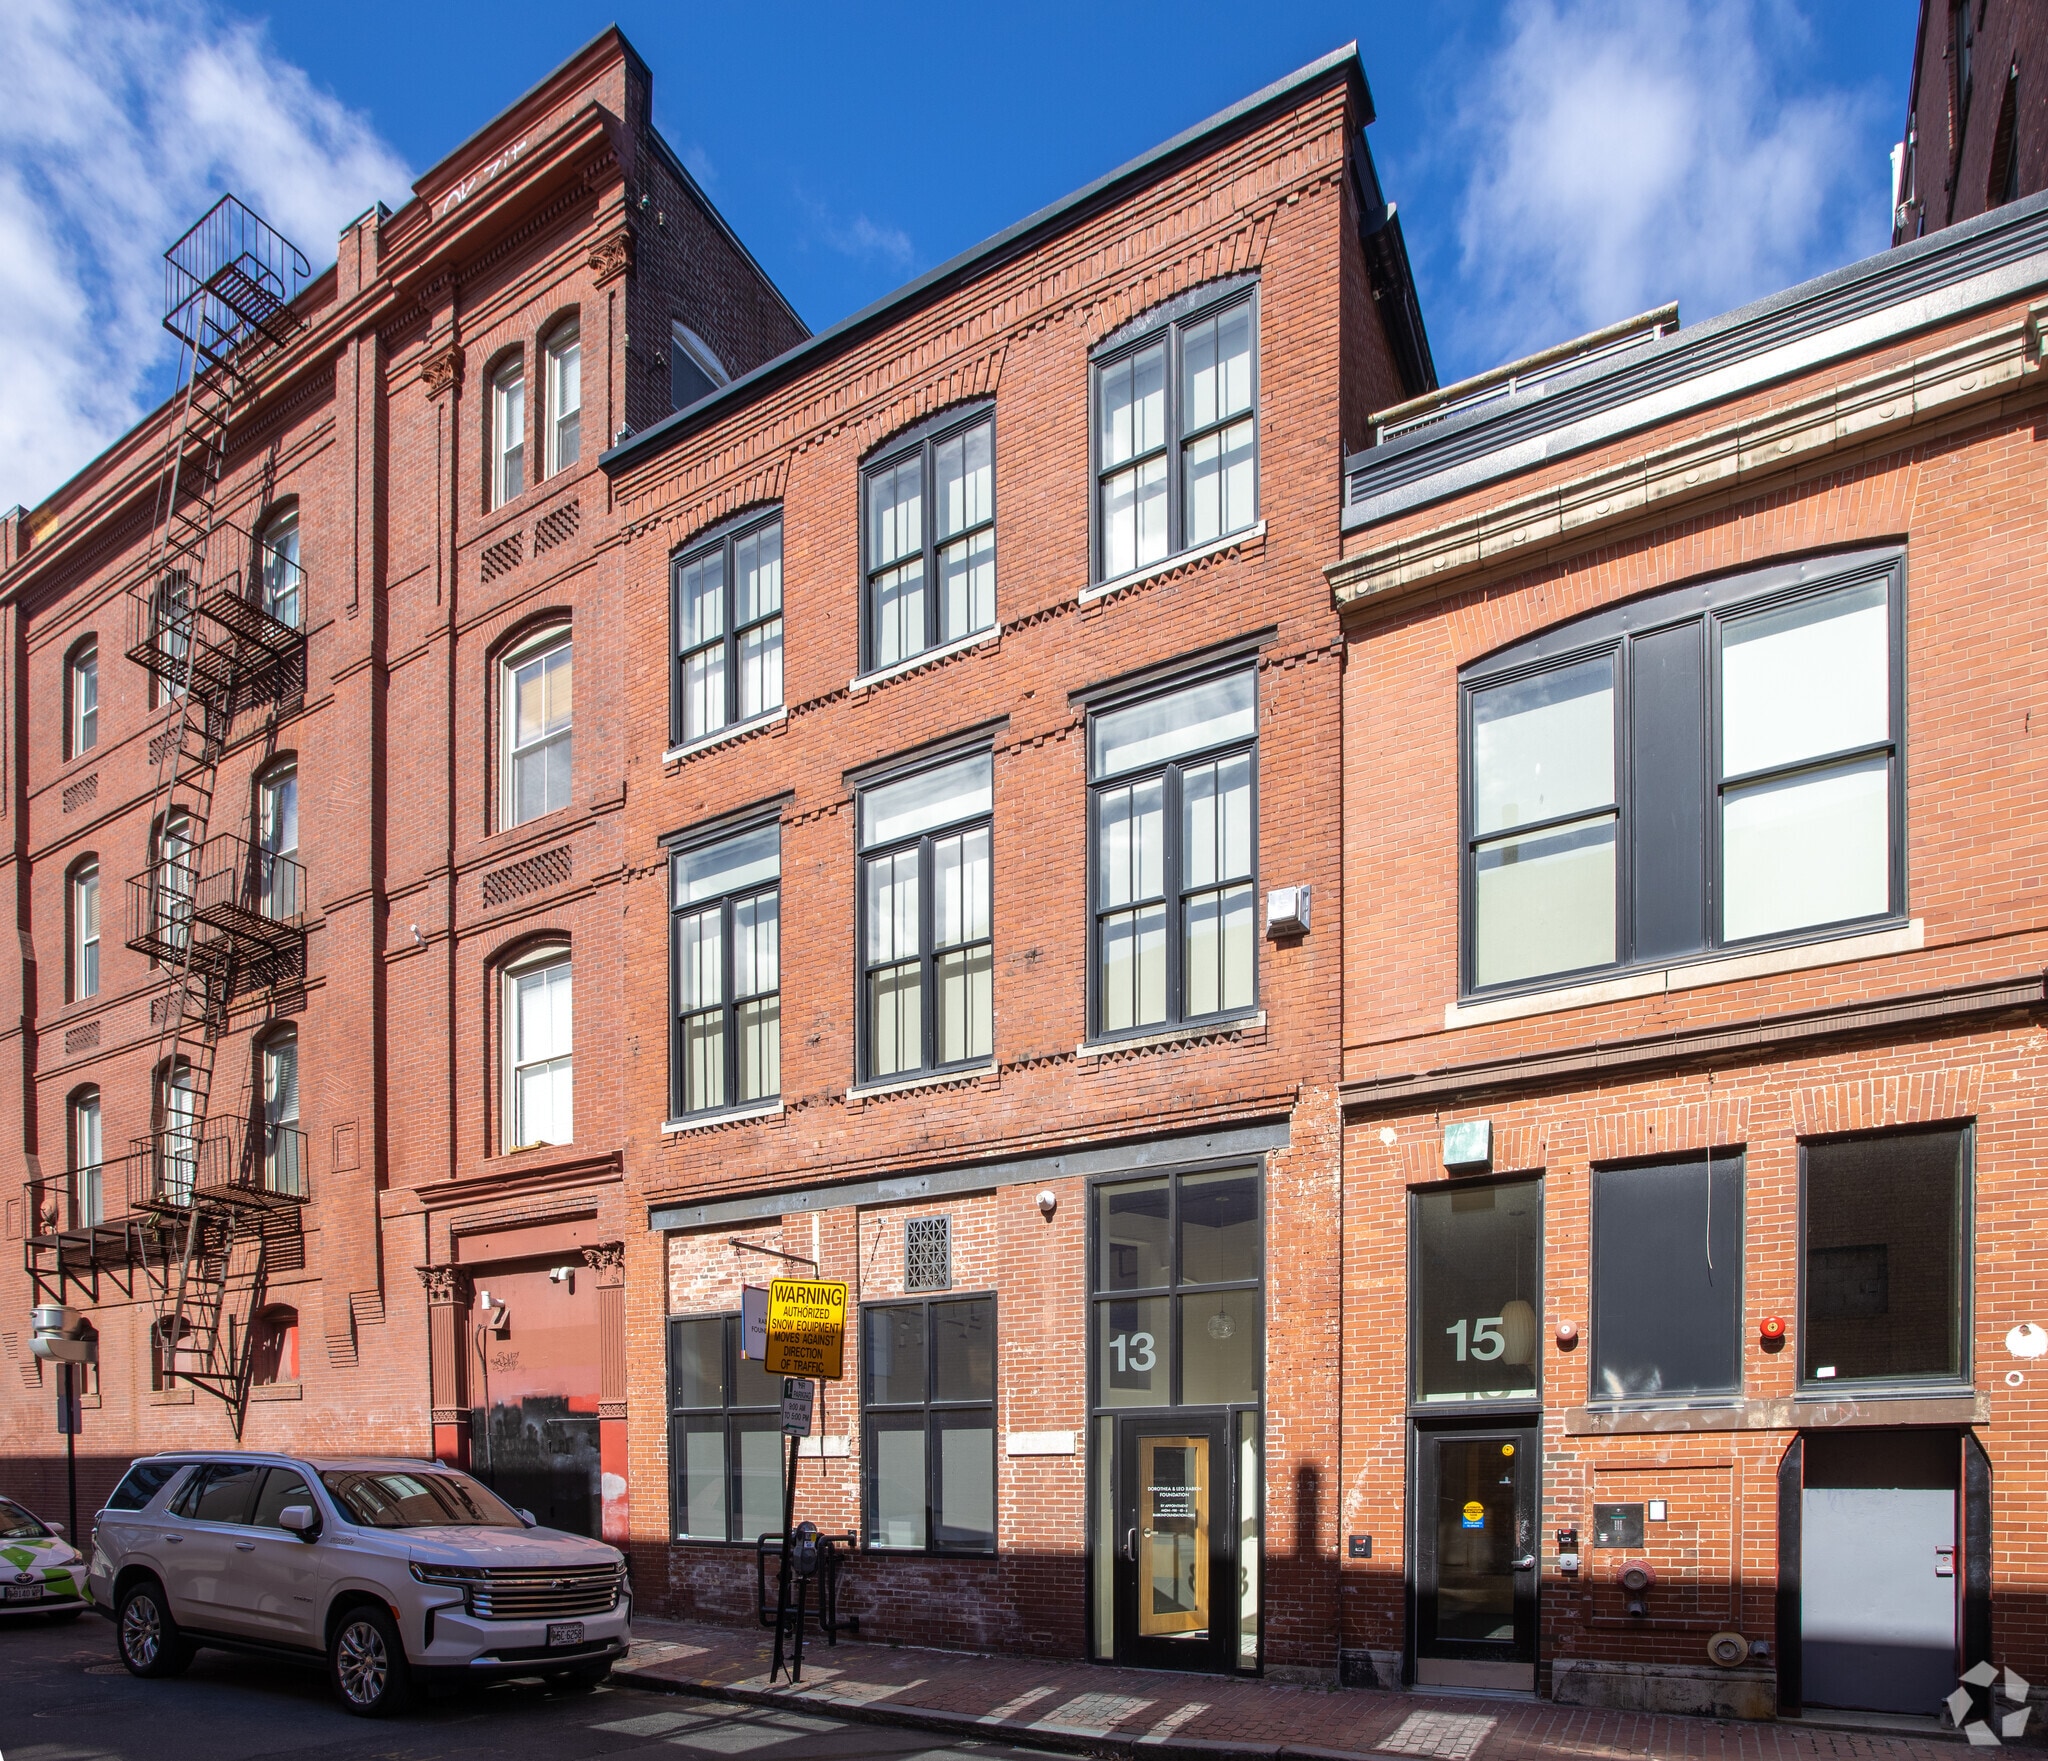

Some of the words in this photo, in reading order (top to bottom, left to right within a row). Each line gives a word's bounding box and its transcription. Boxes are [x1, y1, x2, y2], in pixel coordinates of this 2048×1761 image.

[775, 1285, 842, 1306] WARNING
[783, 1306, 830, 1319] AUTHORIZED
[772, 1318, 793, 1330] SNOW
[797, 1321, 840, 1334] EQUIPMENT
[774, 1332, 800, 1343] MOVES
[802, 1334, 835, 1346] AGAINST
[1446, 1316, 1505, 1361] 15
[784, 1346, 823, 1359] DIRECTION
[1109, 1332, 1157, 1372] 13
[781, 1359, 791, 1369] OF
[794, 1360, 824, 1373] TRAFFIC
[793, 1390, 811, 1399] PARKING
[784, 1411, 790, 1419] TO
[802, 1413, 810, 1421] PM
